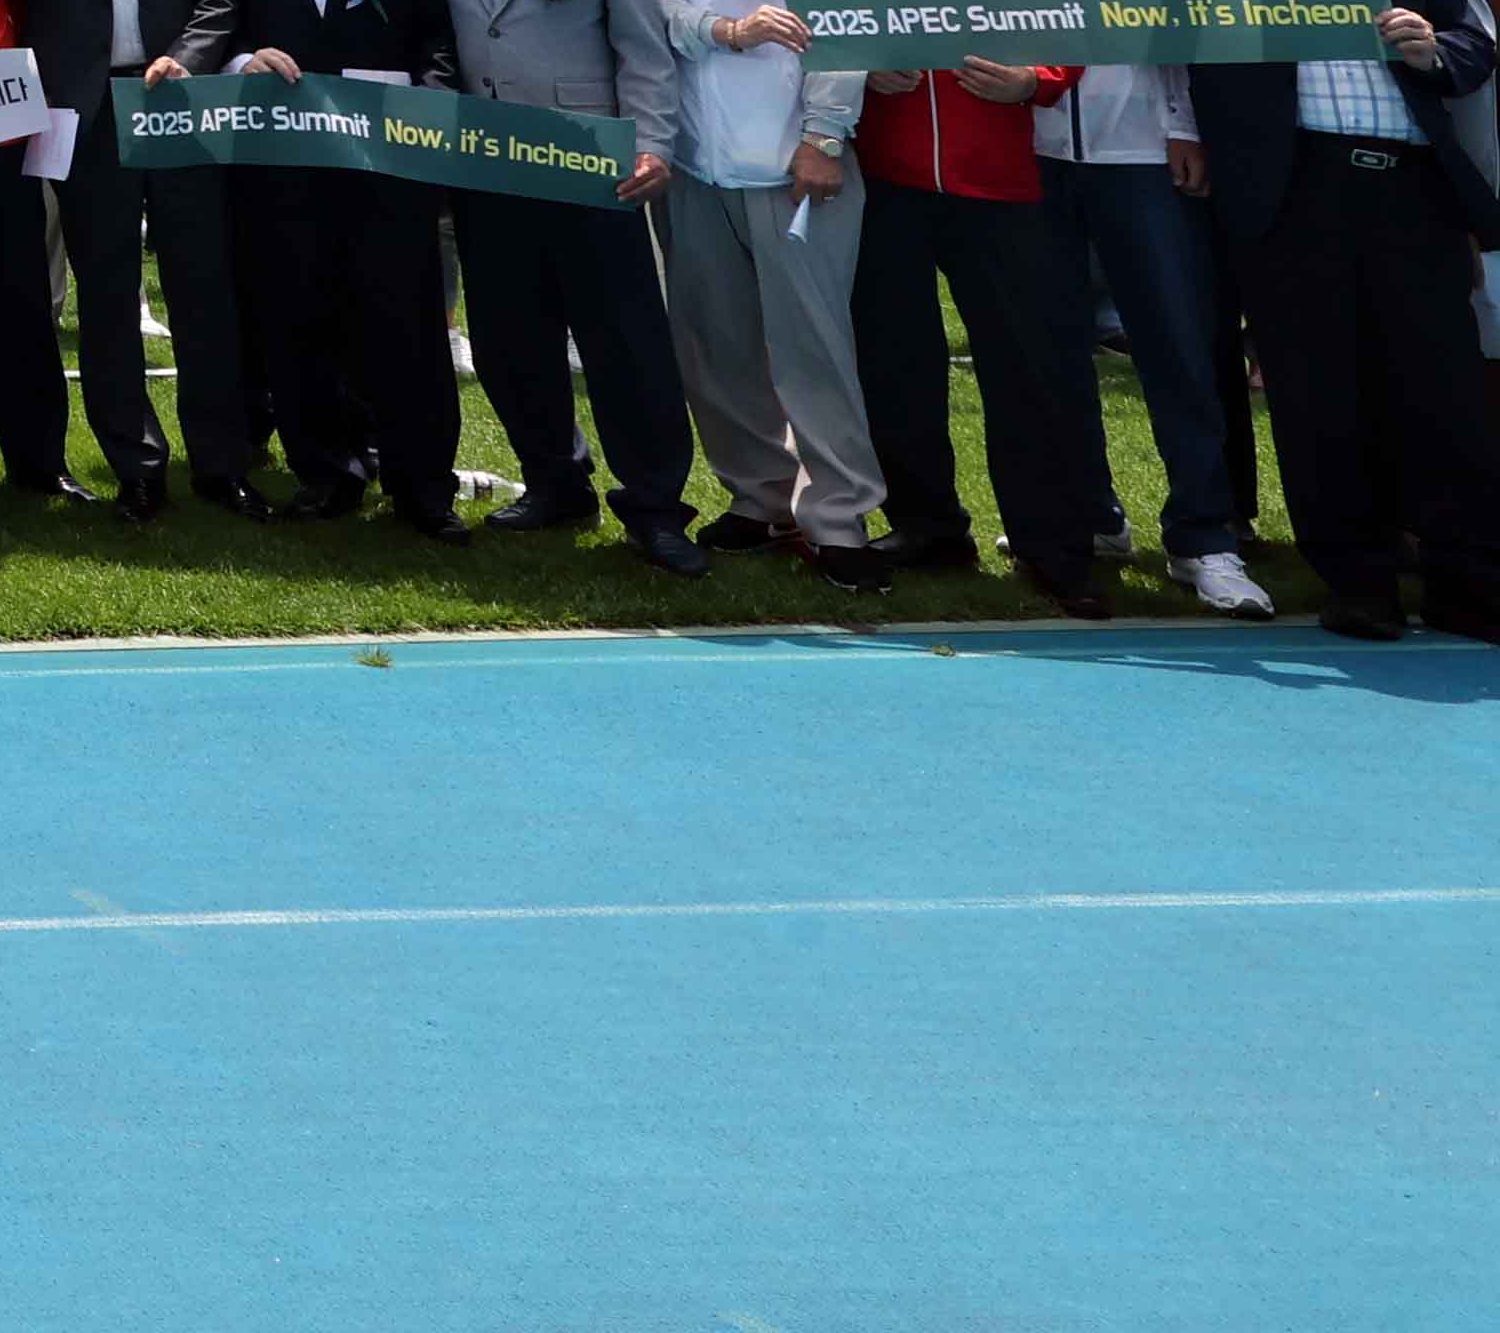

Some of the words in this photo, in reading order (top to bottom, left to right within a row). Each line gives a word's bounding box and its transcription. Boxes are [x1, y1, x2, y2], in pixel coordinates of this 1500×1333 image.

[806, 8, 878, 37] 2025
[886, 6, 961, 35] APEC
[968, 1, 1085, 32] Summit
[1100, 1, 1179, 28] Now,
[131, 110, 194, 137] 2025
[200, 106, 264, 132] APEC
[272, 105, 371, 139] Summit
[384, 117, 451, 152] Now,
[459, 128, 499, 158] it's
[508, 135, 618, 177] Incheon
